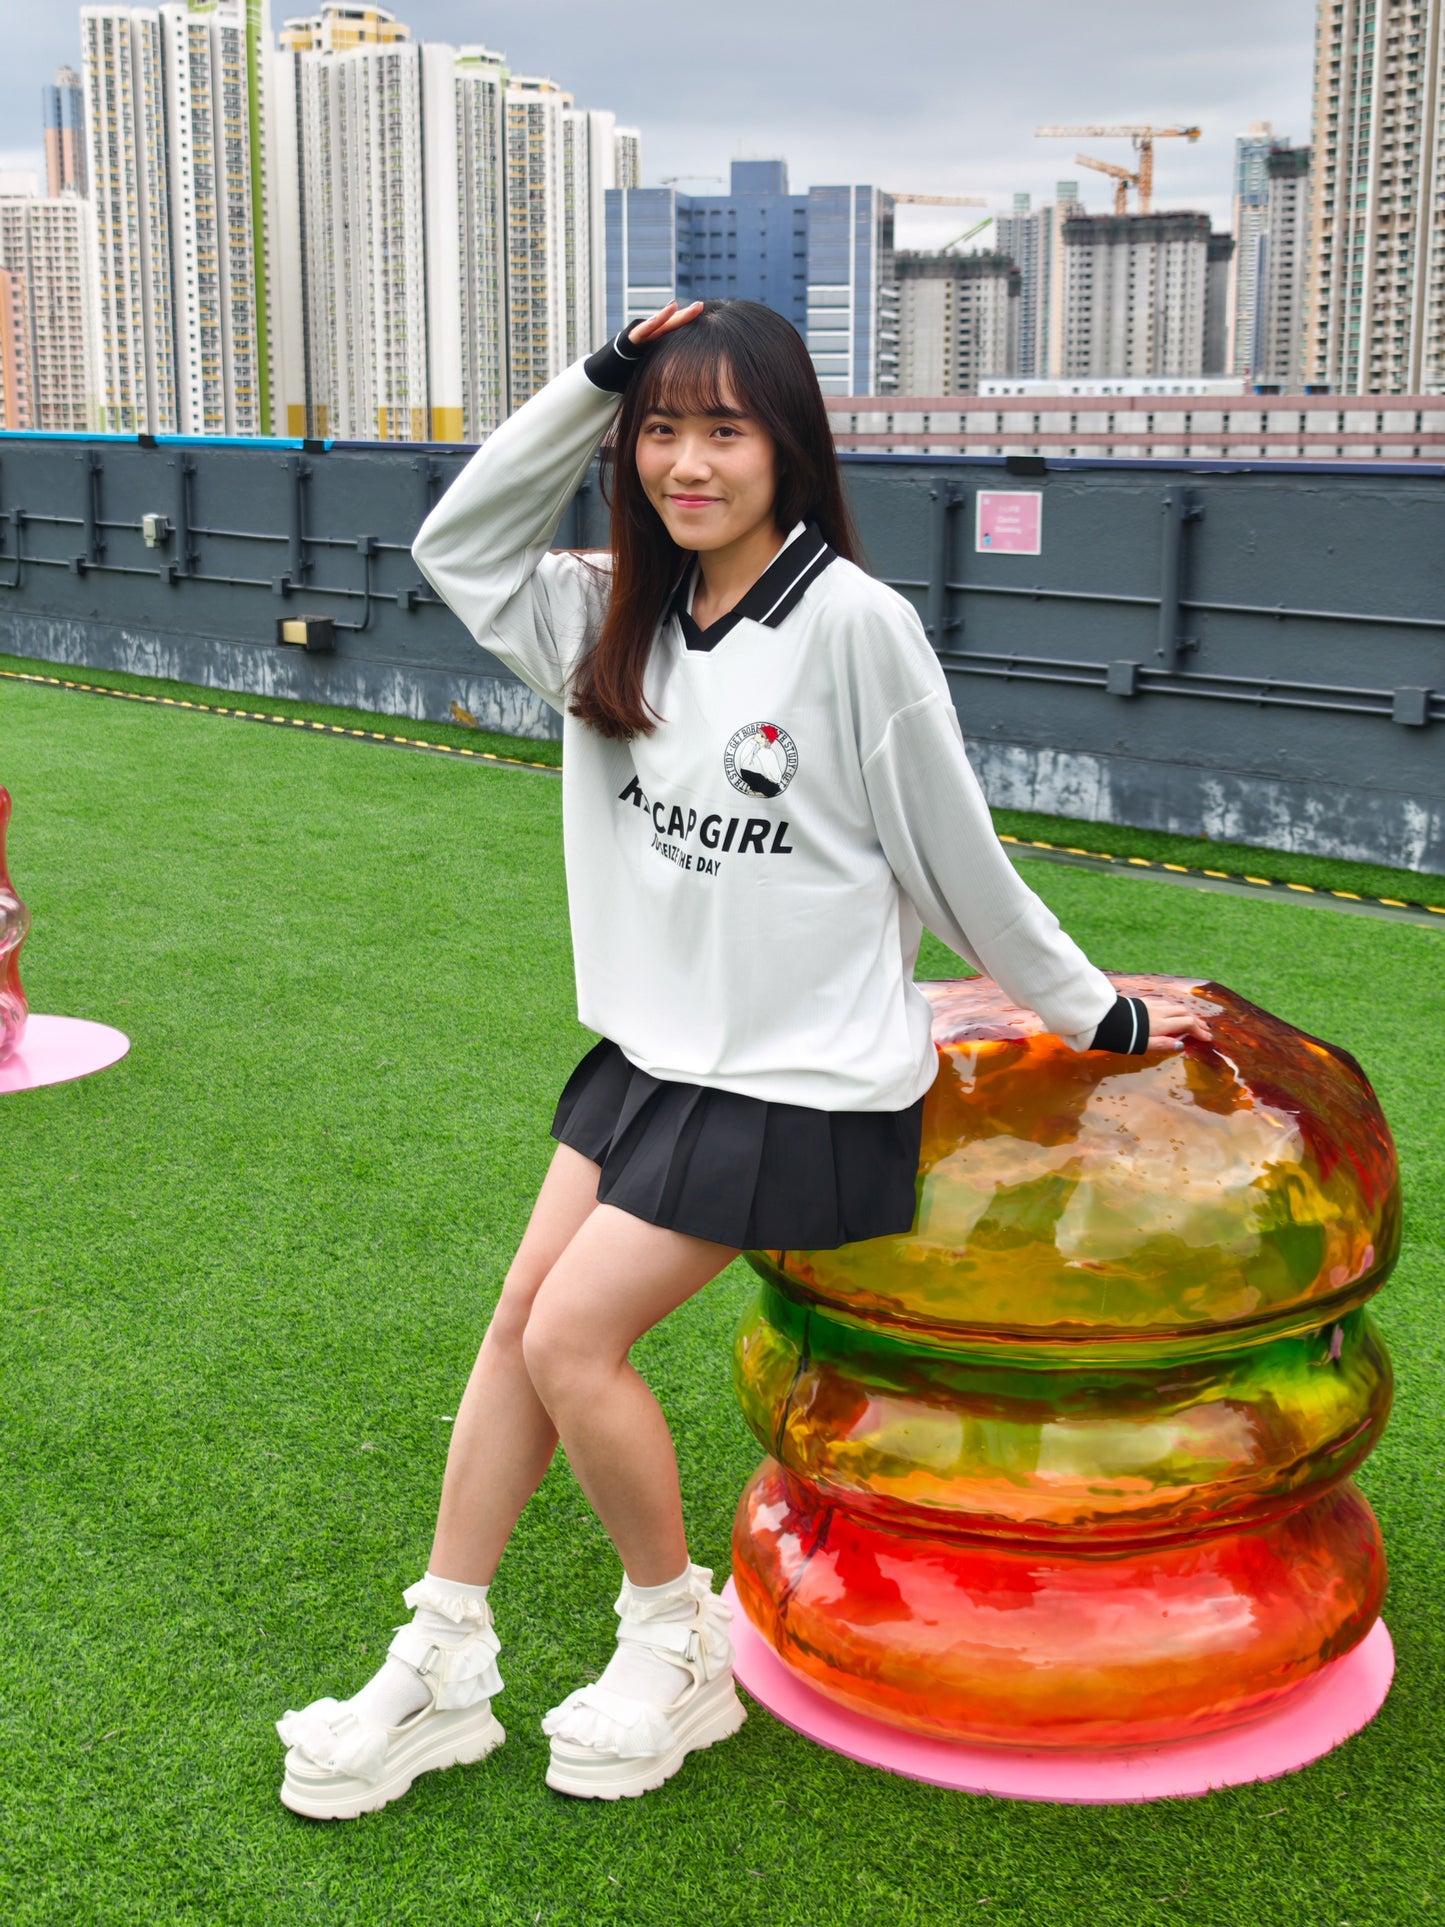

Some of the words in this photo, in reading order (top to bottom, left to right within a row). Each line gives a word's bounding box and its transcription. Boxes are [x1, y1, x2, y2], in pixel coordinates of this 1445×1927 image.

[725, 751, 737, 780] STUDY
[730, 733, 743, 748] GET
[784, 741, 797, 770] STUDY
[696, 856, 722, 877] DAY
